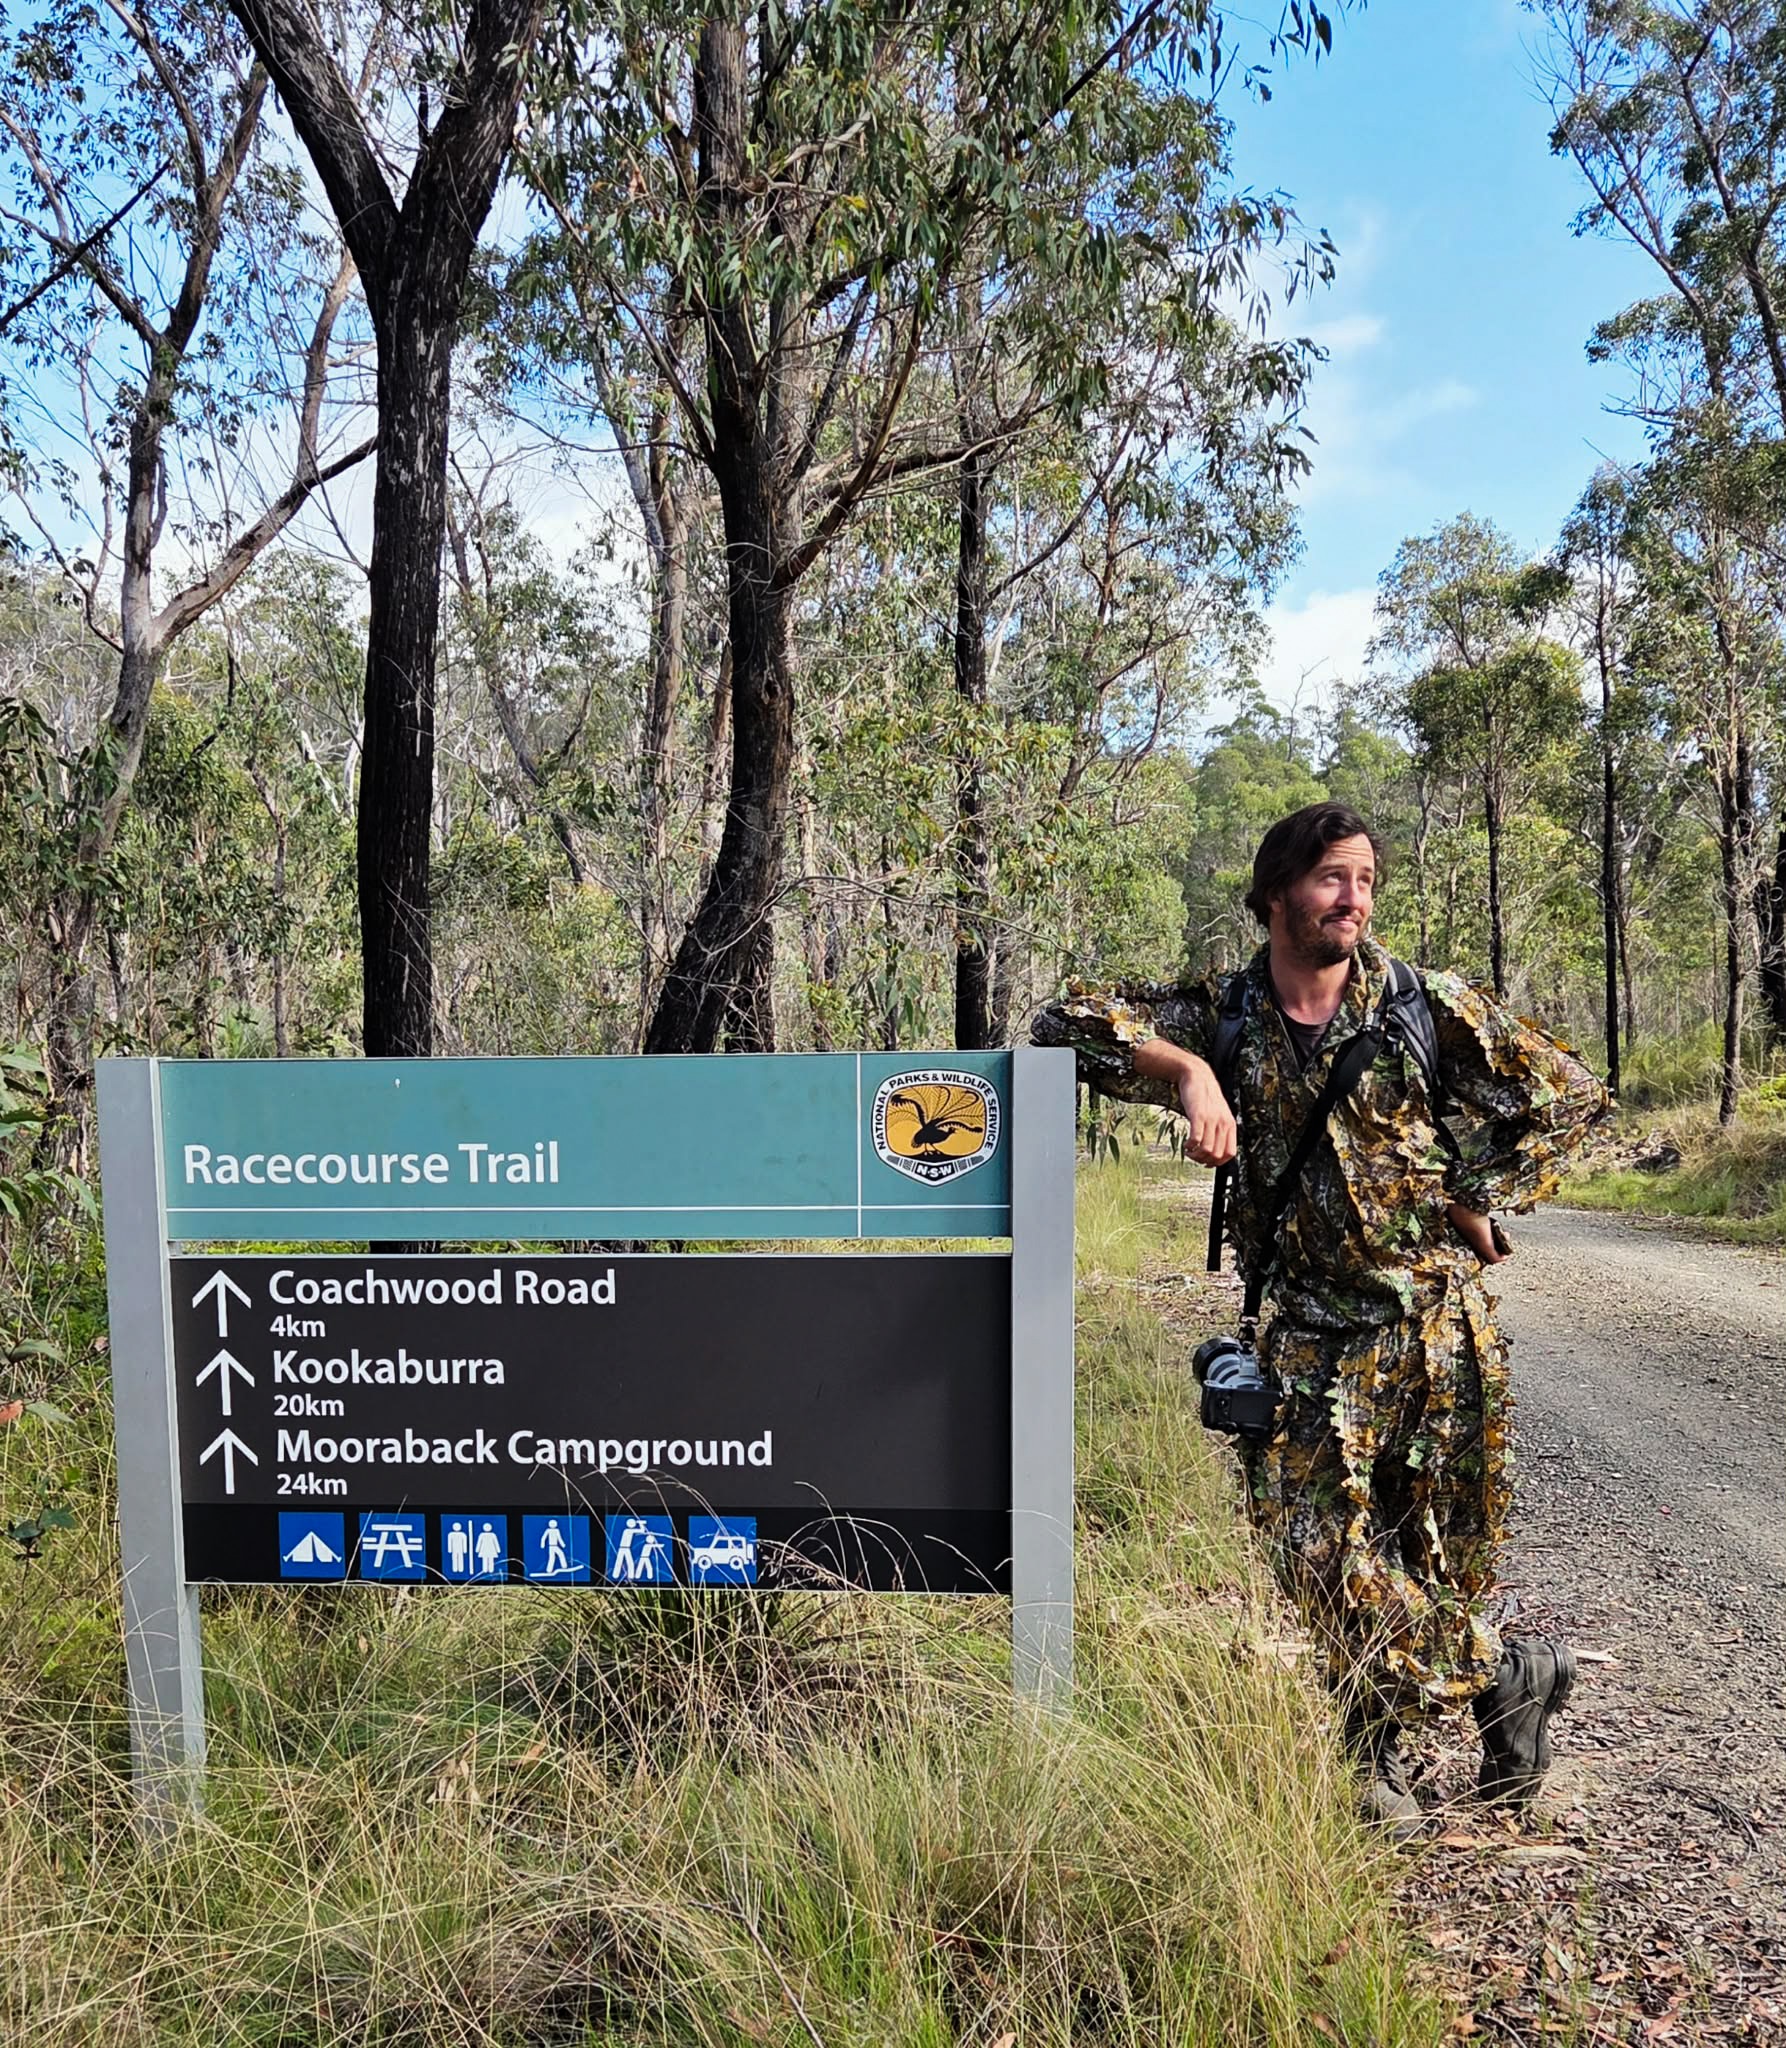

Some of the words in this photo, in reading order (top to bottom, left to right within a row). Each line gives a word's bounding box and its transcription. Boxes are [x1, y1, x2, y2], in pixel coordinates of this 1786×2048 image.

[875, 1089, 889, 1149] NATIONAL
[889, 1073, 930, 1088] PARKS
[931, 1073, 939, 1081] &
[941, 1073, 993, 1097] WILDLIFE
[985, 1098, 997, 1149] SERVICE
[184, 1144, 449, 1184] Racecourse
[458, 1141, 559, 1183] Trail
[268, 1268, 503, 1305] Coachwood
[515, 1268, 617, 1305] Road
[269, 1314, 326, 1338] 4km
[273, 1348, 505, 1385] Kookaburra
[273, 1393, 345, 1417] 20km
[277, 1428, 500, 1464] Mooraback
[507, 1429, 773, 1473] Campground
[276, 1472, 348, 1496] 24km
